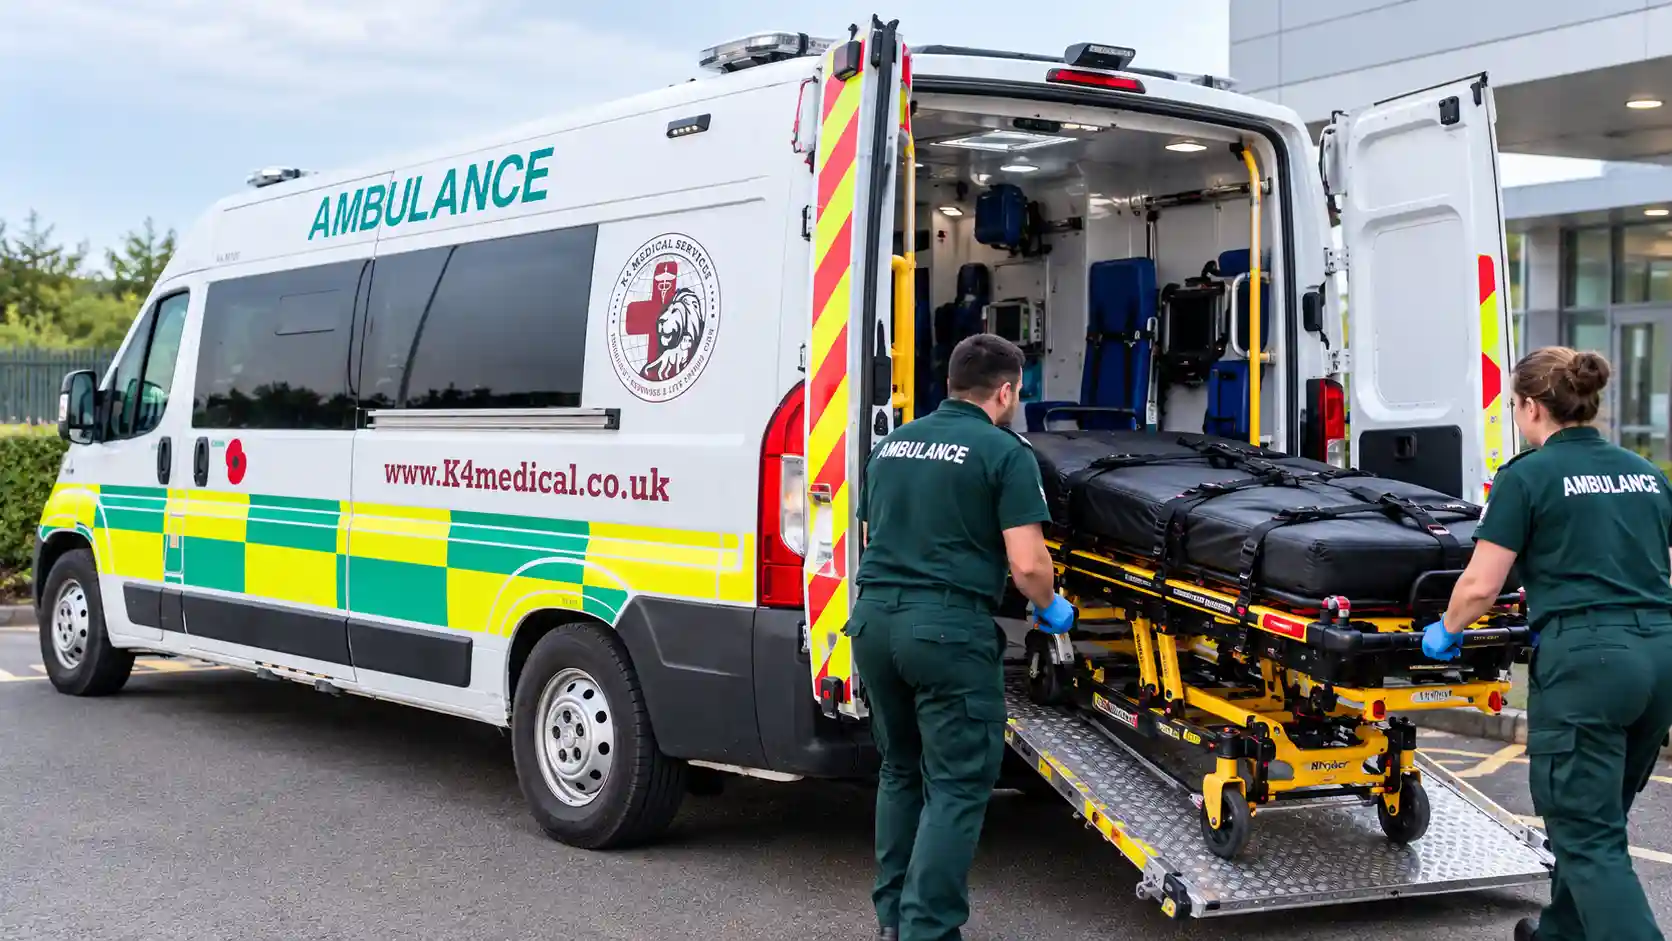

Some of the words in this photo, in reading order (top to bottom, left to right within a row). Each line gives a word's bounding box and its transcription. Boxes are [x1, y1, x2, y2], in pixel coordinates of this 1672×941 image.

[308, 147, 554, 240] AMBULANCE
[631, 238, 673, 271] MEDICAL
[675, 239, 712, 280] SERVICES
[876, 440, 970, 464] AMBULANCE
[384, 459, 670, 501] www.K4medical.co.uk
[1563, 474, 1660, 497] AMBULANCE
